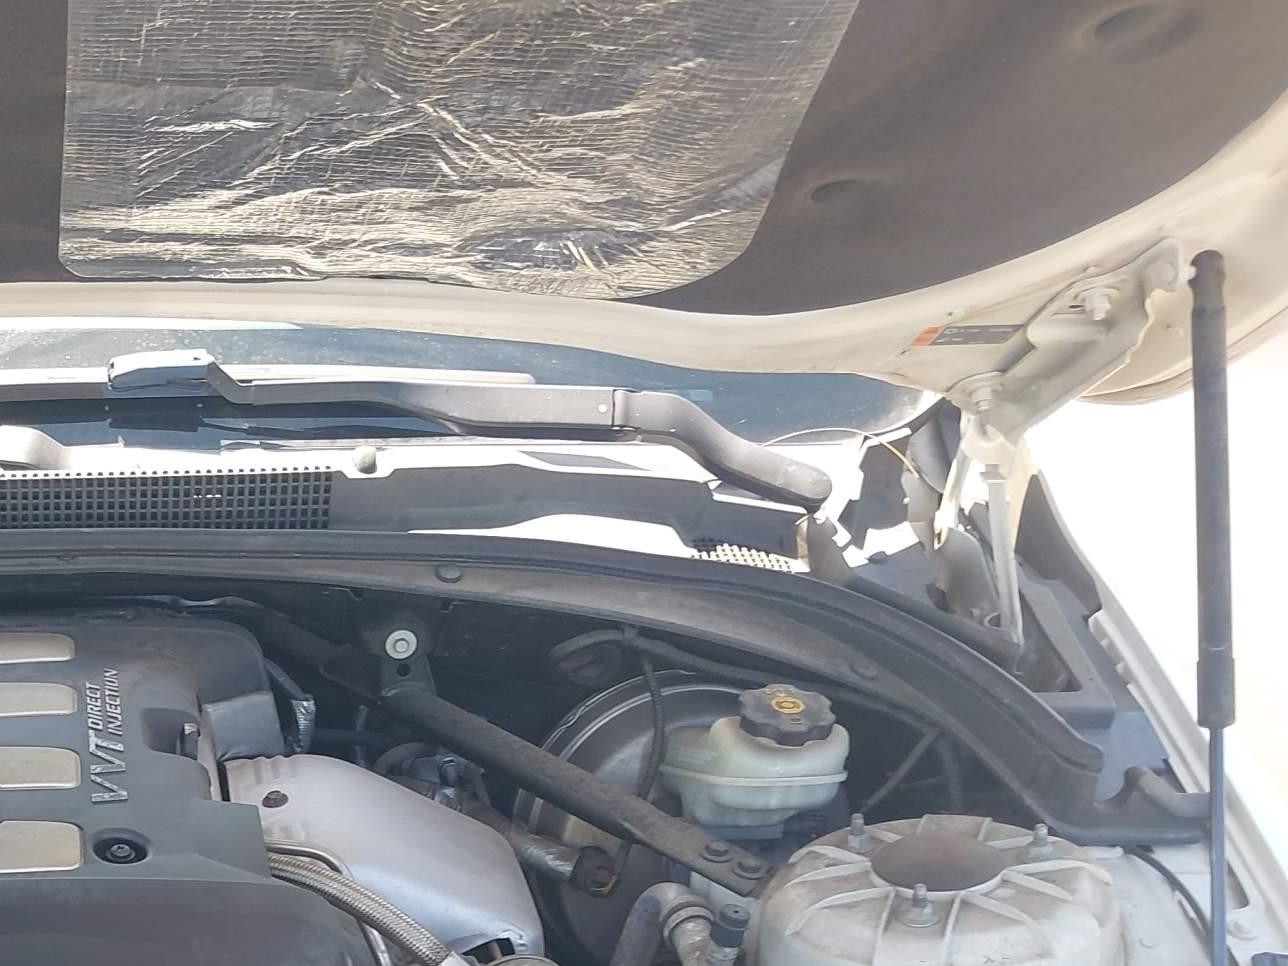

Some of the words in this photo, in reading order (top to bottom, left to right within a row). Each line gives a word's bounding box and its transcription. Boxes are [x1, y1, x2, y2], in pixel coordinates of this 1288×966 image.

[85, 680, 104, 731] DIRECT
[103, 667, 124, 737] INJECTION
[88, 729, 129, 803] VVT
